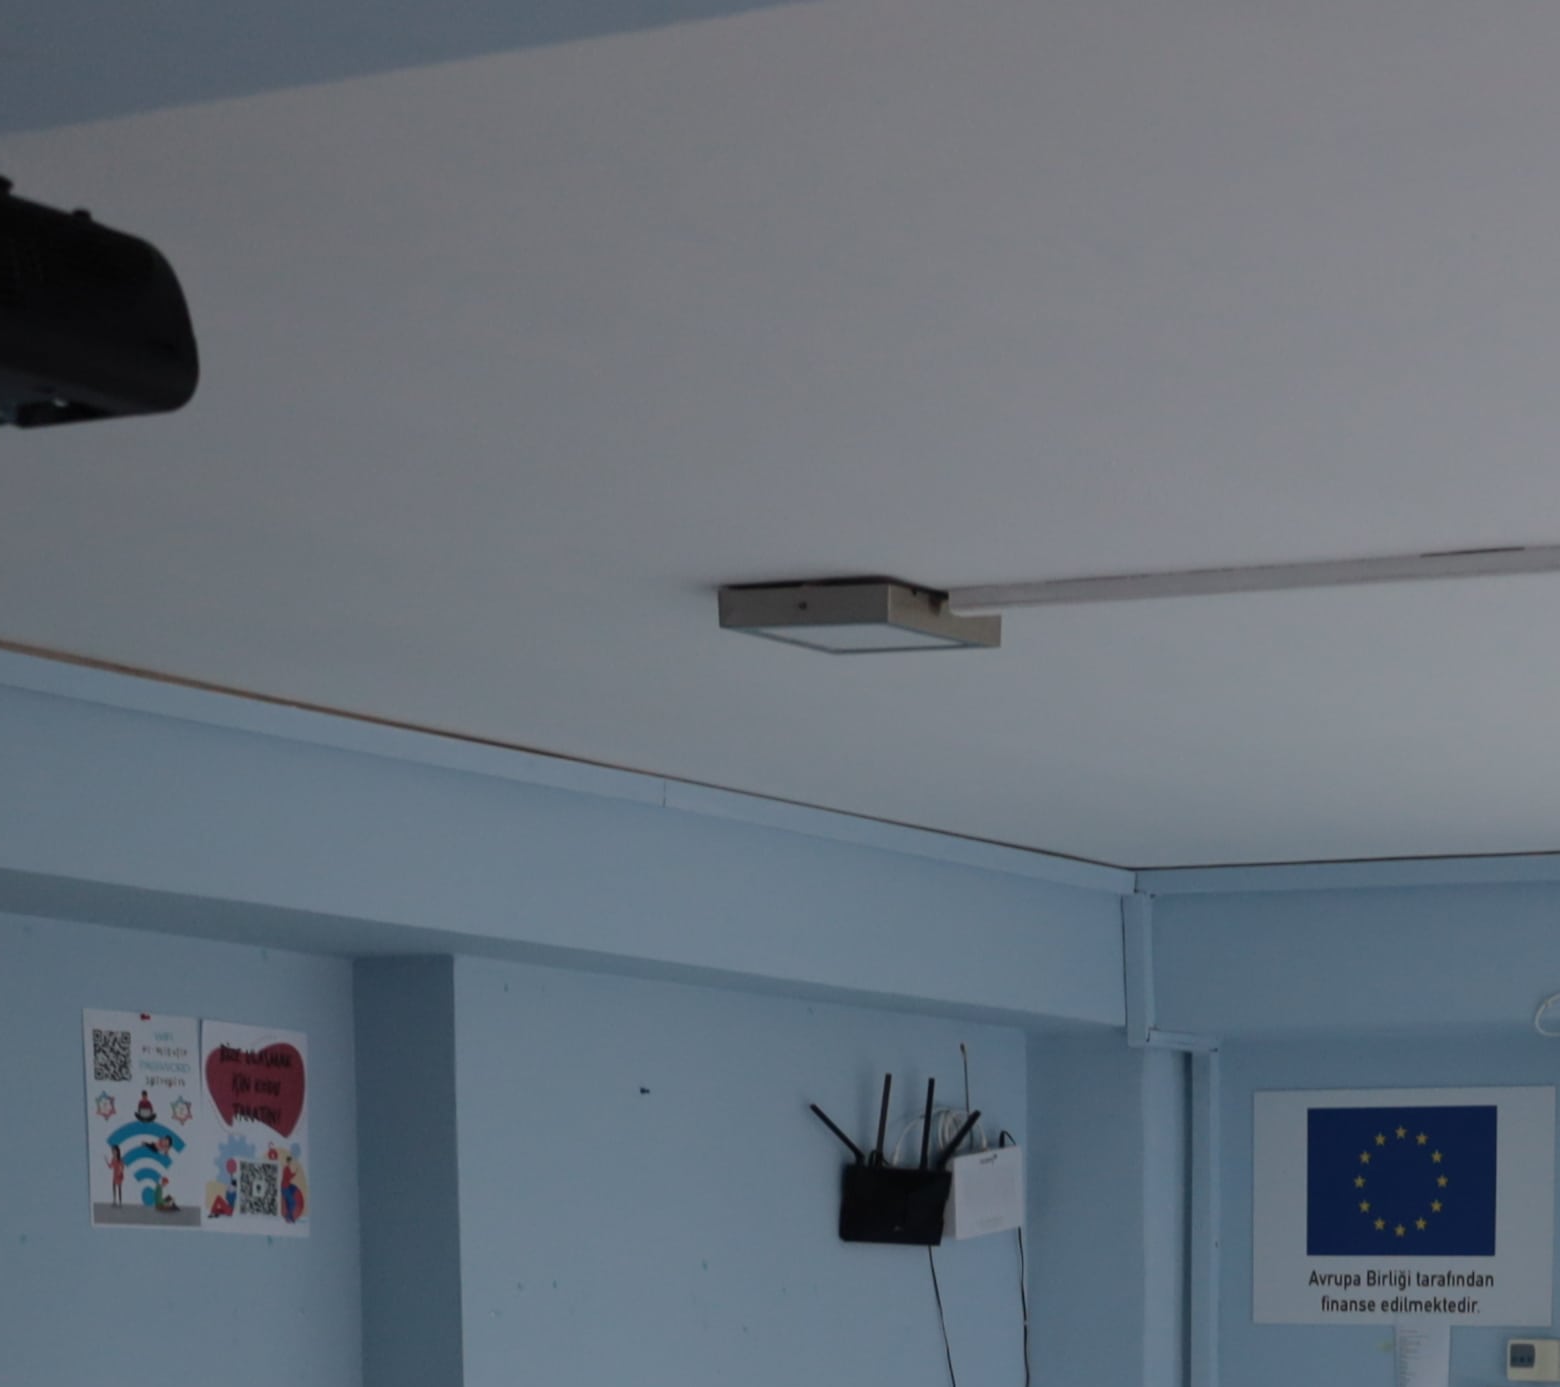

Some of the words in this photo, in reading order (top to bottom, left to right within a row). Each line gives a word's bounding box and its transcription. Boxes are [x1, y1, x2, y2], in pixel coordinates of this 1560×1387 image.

[1308, 1270, 1361, 1290] Avrupa
[1366, 1270, 1412, 1291] Birliği
[1416, 1270, 1494, 1287] tarafından
[1321, 1296, 1376, 1314] finanse
[1381, 1296, 1481, 1314] edilmektedir.
